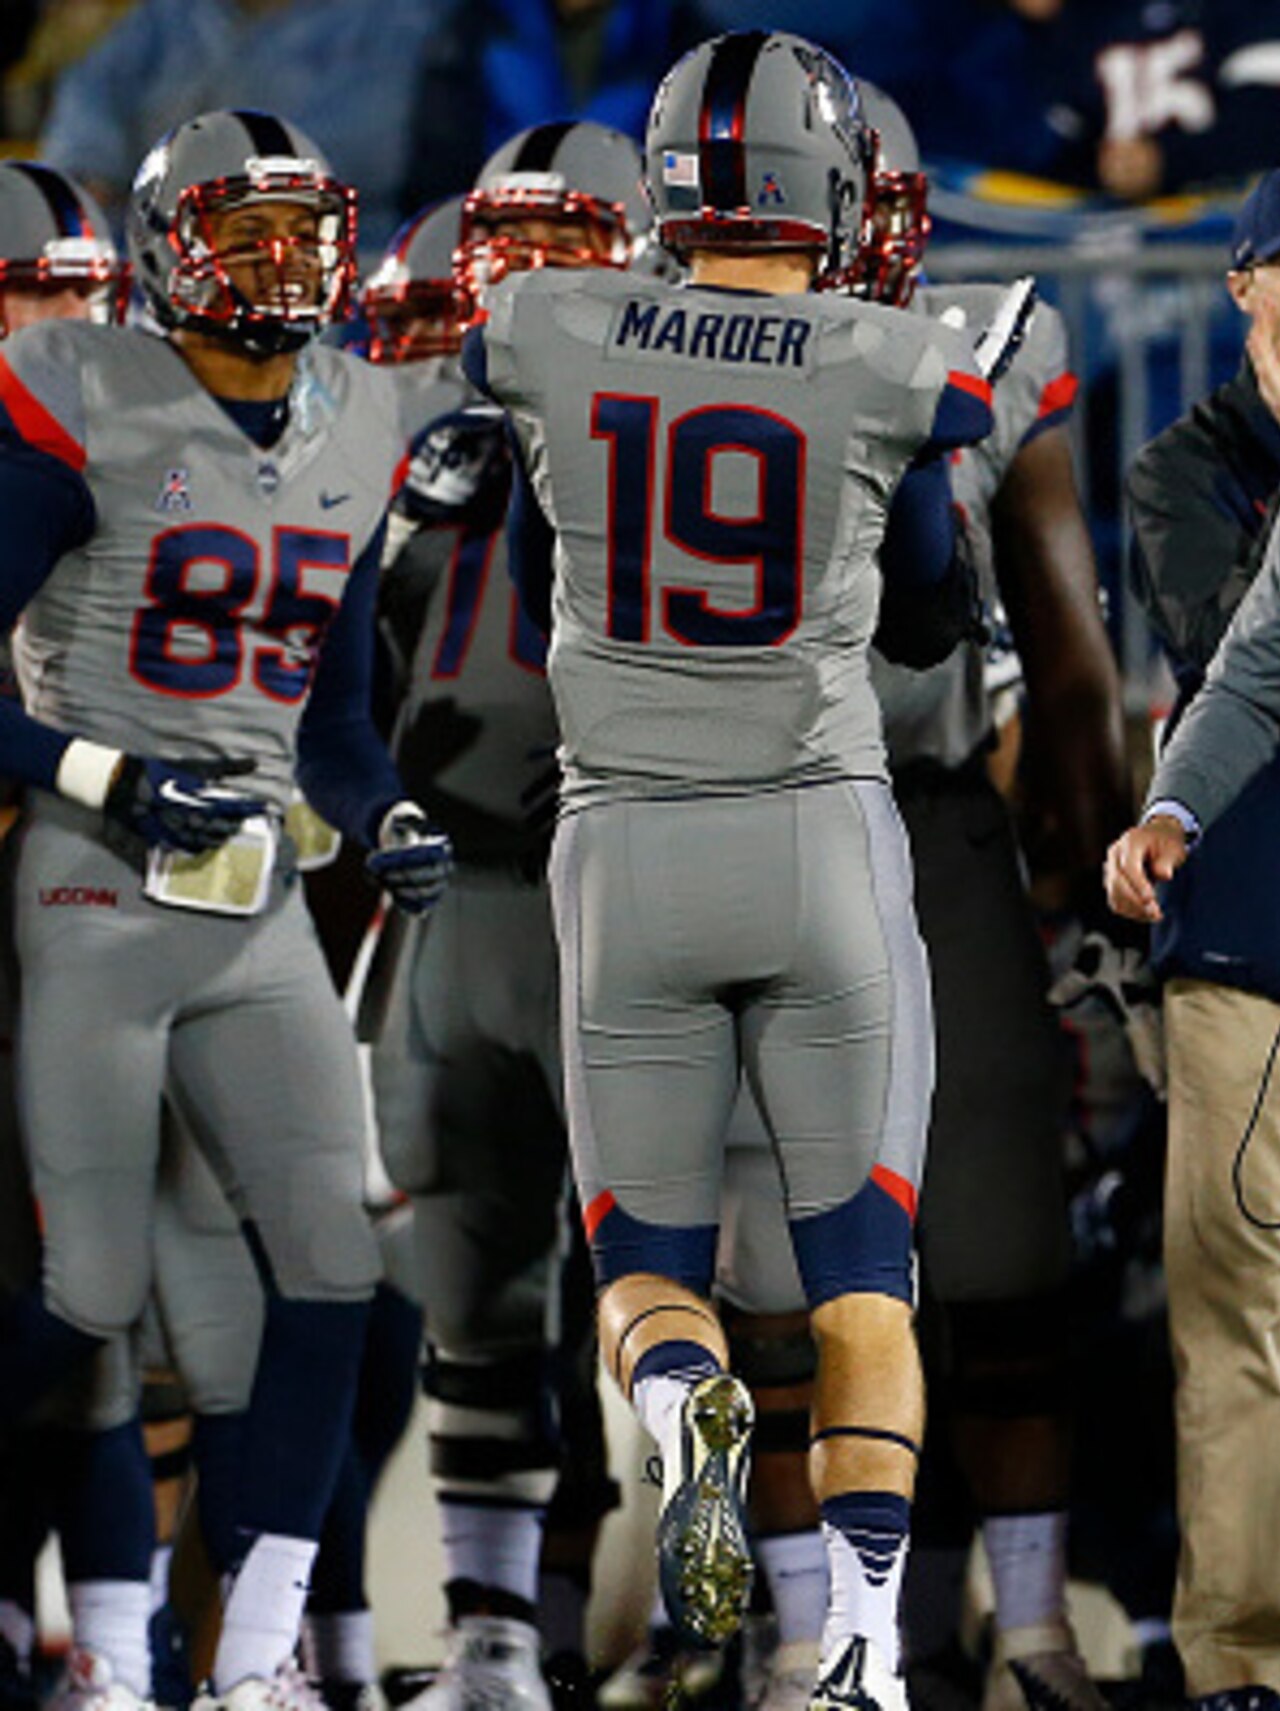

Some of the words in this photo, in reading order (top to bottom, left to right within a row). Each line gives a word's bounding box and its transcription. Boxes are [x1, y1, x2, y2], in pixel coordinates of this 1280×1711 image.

[615, 301, 811, 367] MARDER
[590, 390, 808, 648] 19
[128, 521, 352, 706] 85
